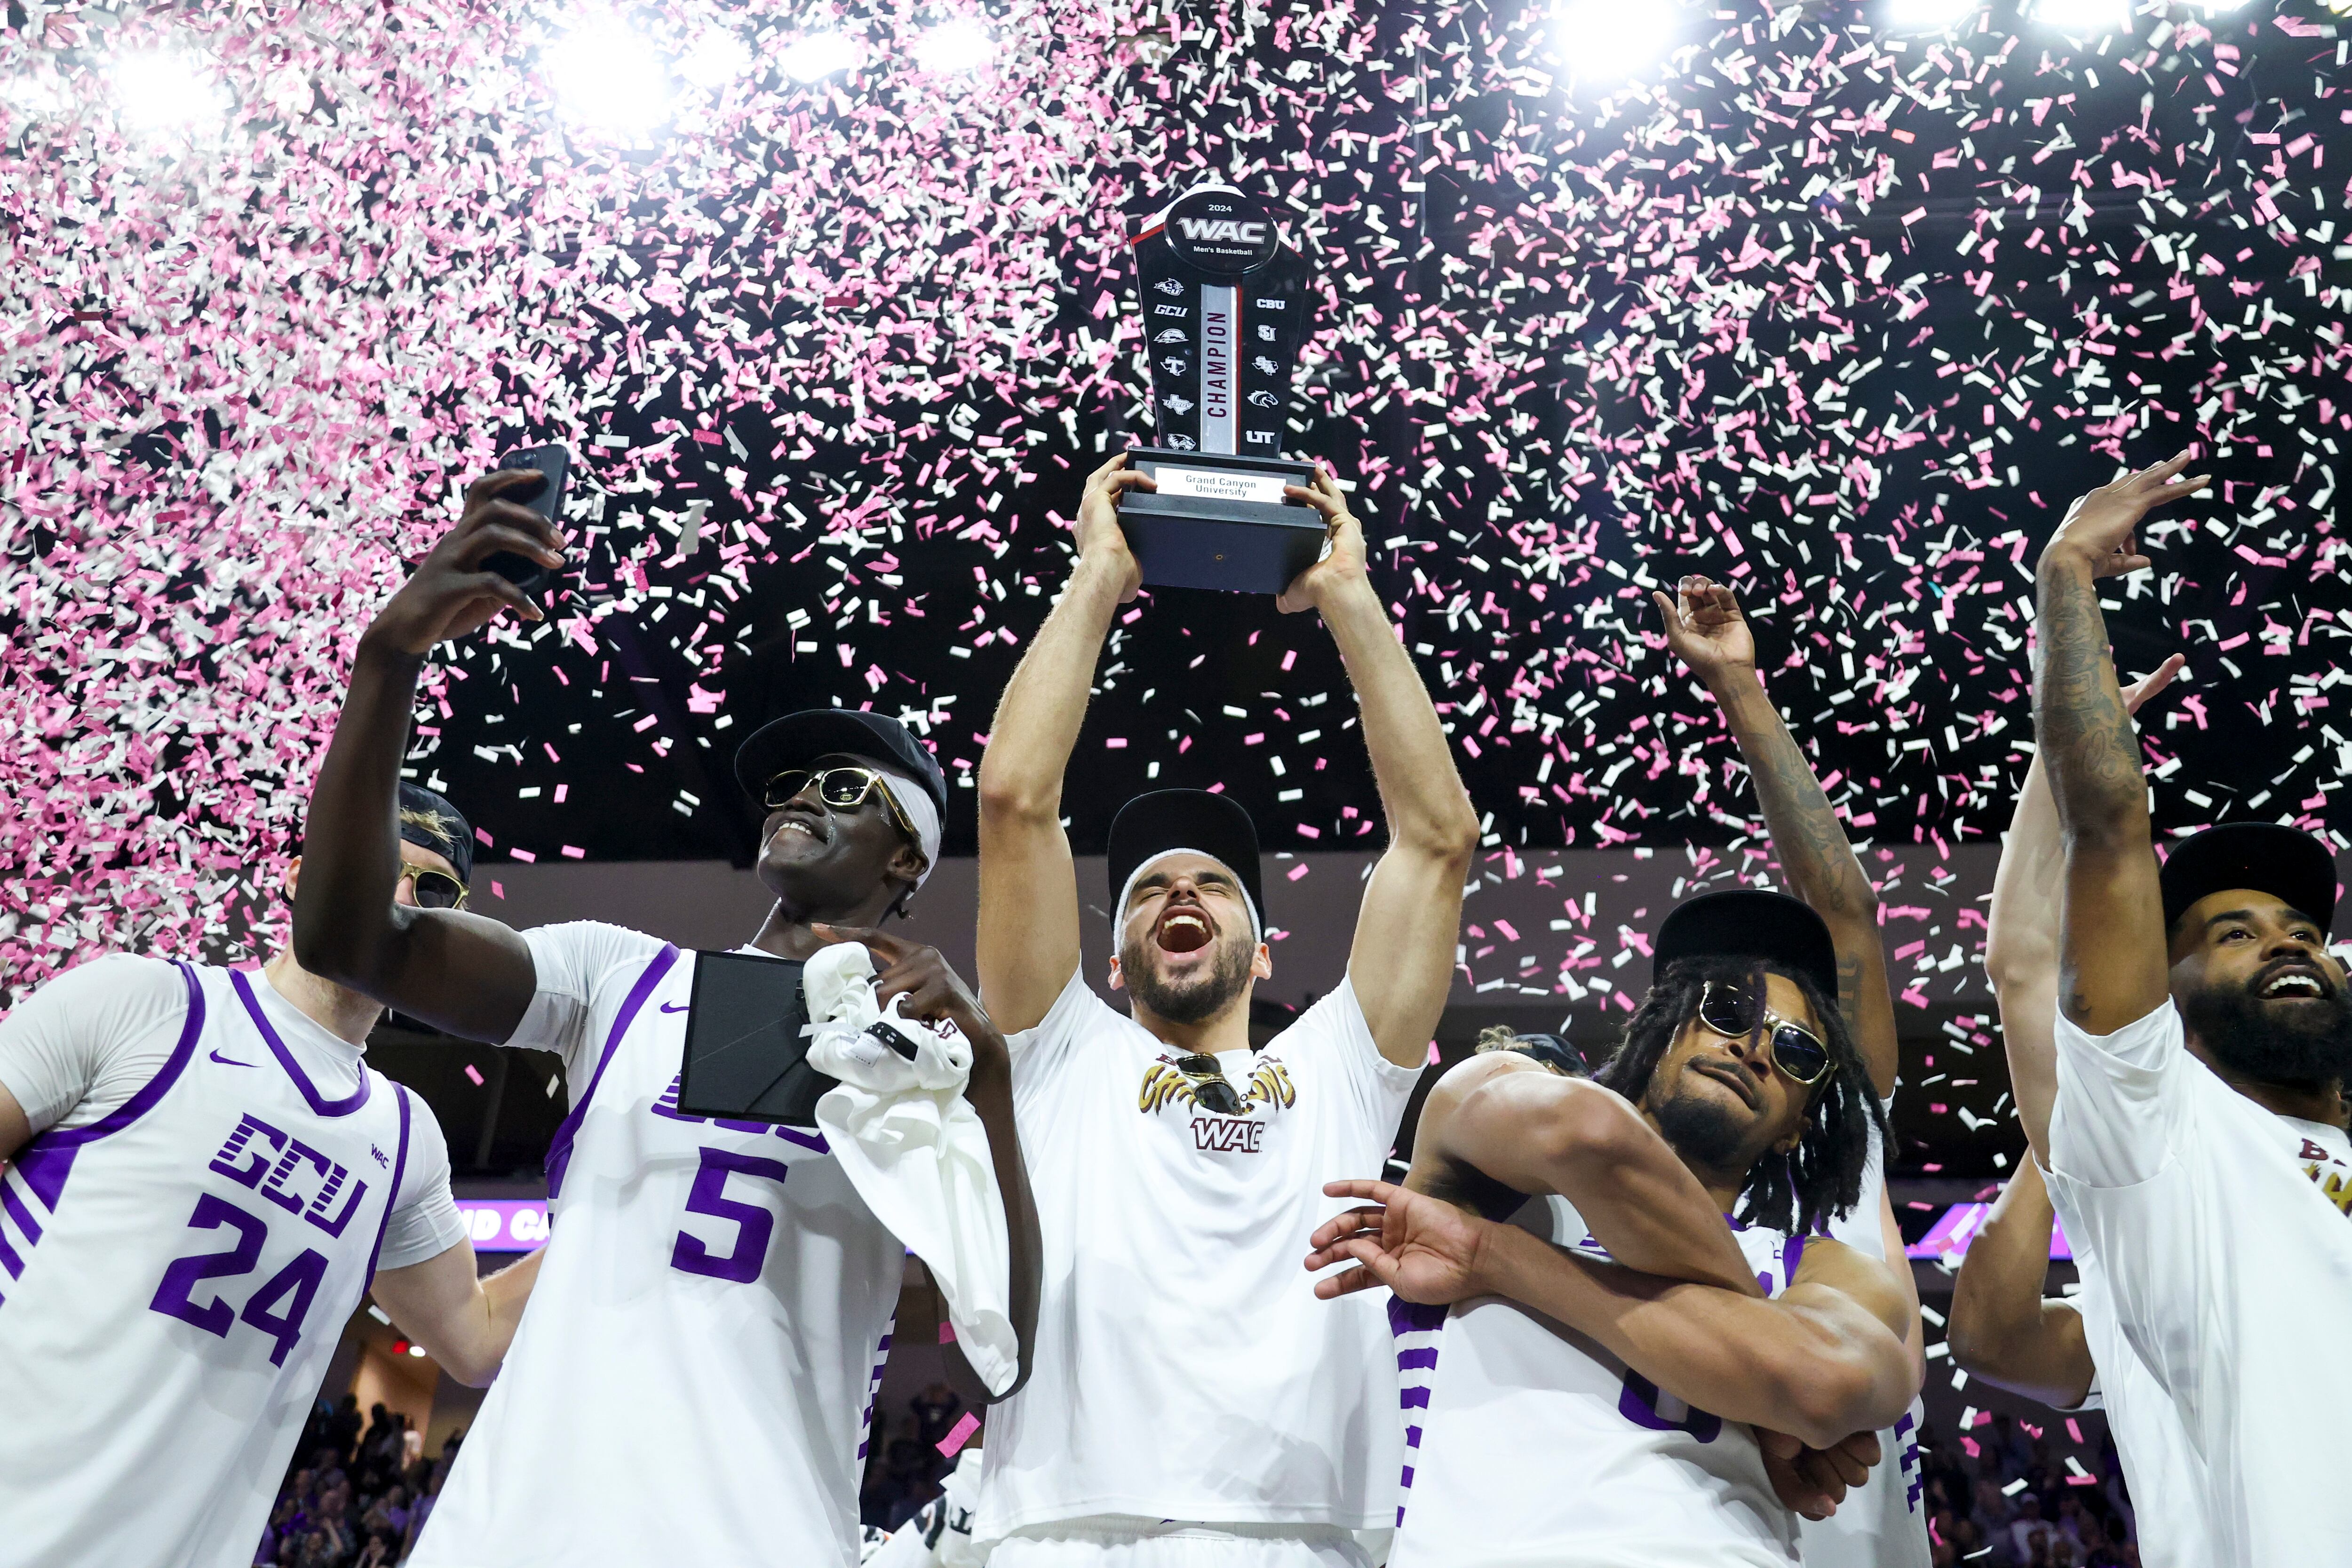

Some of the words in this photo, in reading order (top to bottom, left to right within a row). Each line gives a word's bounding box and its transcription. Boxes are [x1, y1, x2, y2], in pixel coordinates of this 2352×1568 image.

[1176, 217, 1267, 244] WAC
[1216, 247, 1253, 255] Basketball
[1154, 304, 1188, 318] GCU
[1256, 299, 1286, 310] CBU
[1207, 312, 1227, 418] CHAMPION
[1186, 475, 1215, 485] Grand
[1219, 478, 1256, 489] Canyon
[1196, 484, 1247, 498] University
[1190, 1118, 1265, 1153] WAC
[371, 1143, 389, 1170] WAC
[209, 1112, 369, 1239] GCU
[670, 1146, 788, 1284] 5
[149, 1192, 329, 1369] 24
